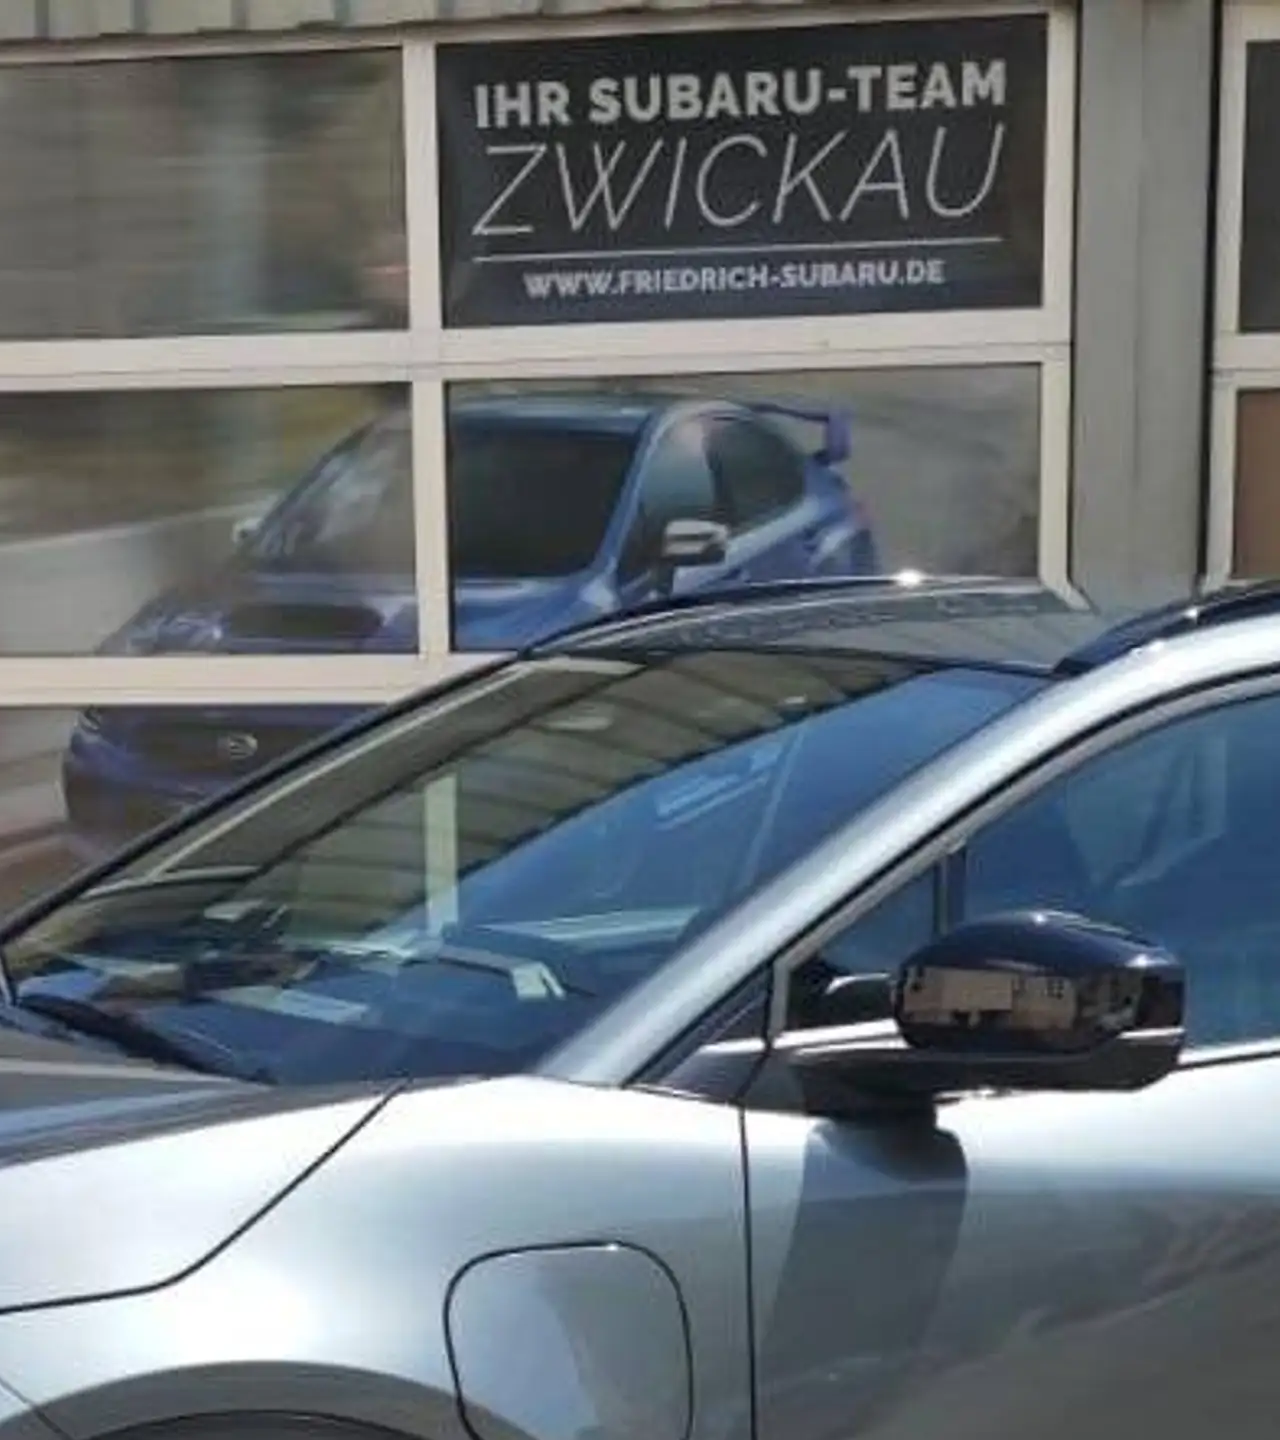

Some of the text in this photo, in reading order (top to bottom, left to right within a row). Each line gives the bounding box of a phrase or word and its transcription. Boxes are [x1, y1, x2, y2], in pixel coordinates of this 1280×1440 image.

[475, 59, 1007, 129] IHR SUBARU-TEAM
[471, 122, 1005, 237] ZWICKAU
[523, 259, 946, 298] WWW.FRIEDRICH-SUBARU.DE
